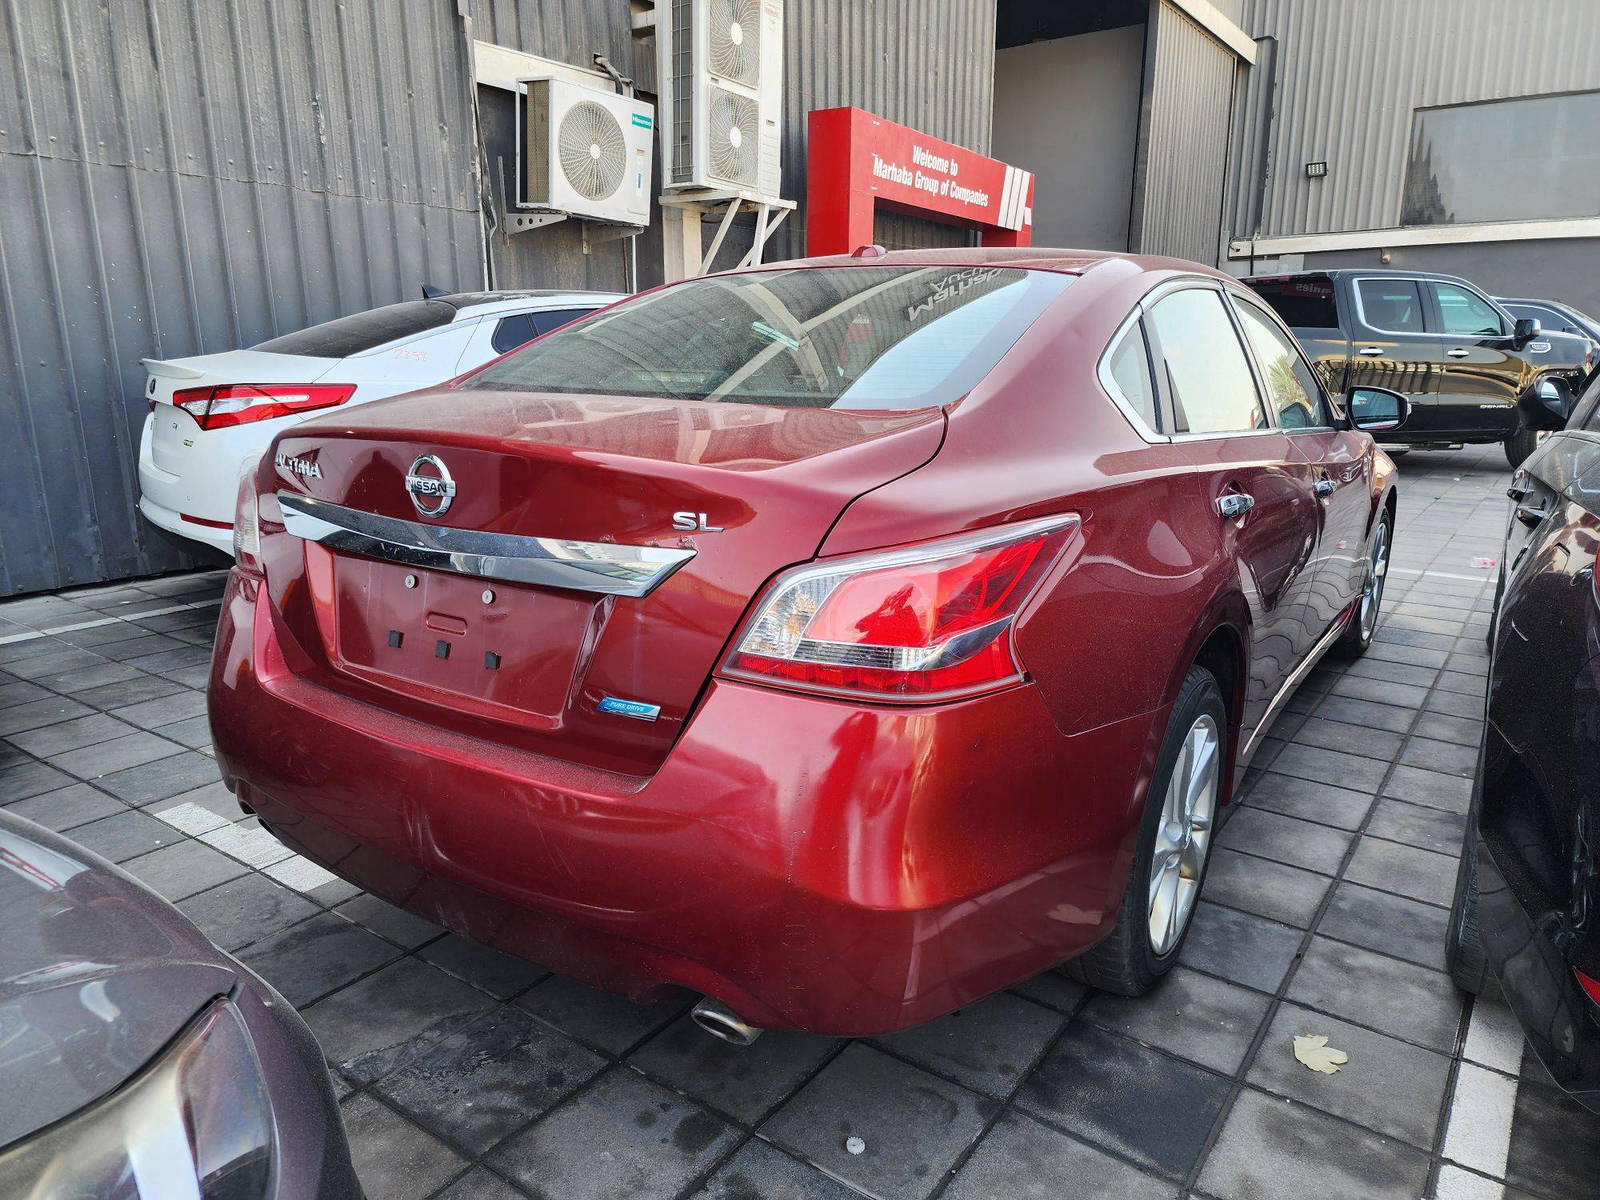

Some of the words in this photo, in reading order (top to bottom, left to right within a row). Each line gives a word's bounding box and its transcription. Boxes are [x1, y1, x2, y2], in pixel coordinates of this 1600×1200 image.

[912, 145, 949, 172] Welcome
[950, 158, 958, 177] to
[873, 156, 913, 186] Marhaba
[915, 170, 938, 196] Group
[940, 179, 950, 194] of
[950, 181, 989, 207] Companies
[407, 478, 448, 494] NISSAN
[672, 511, 725, 532] SL
